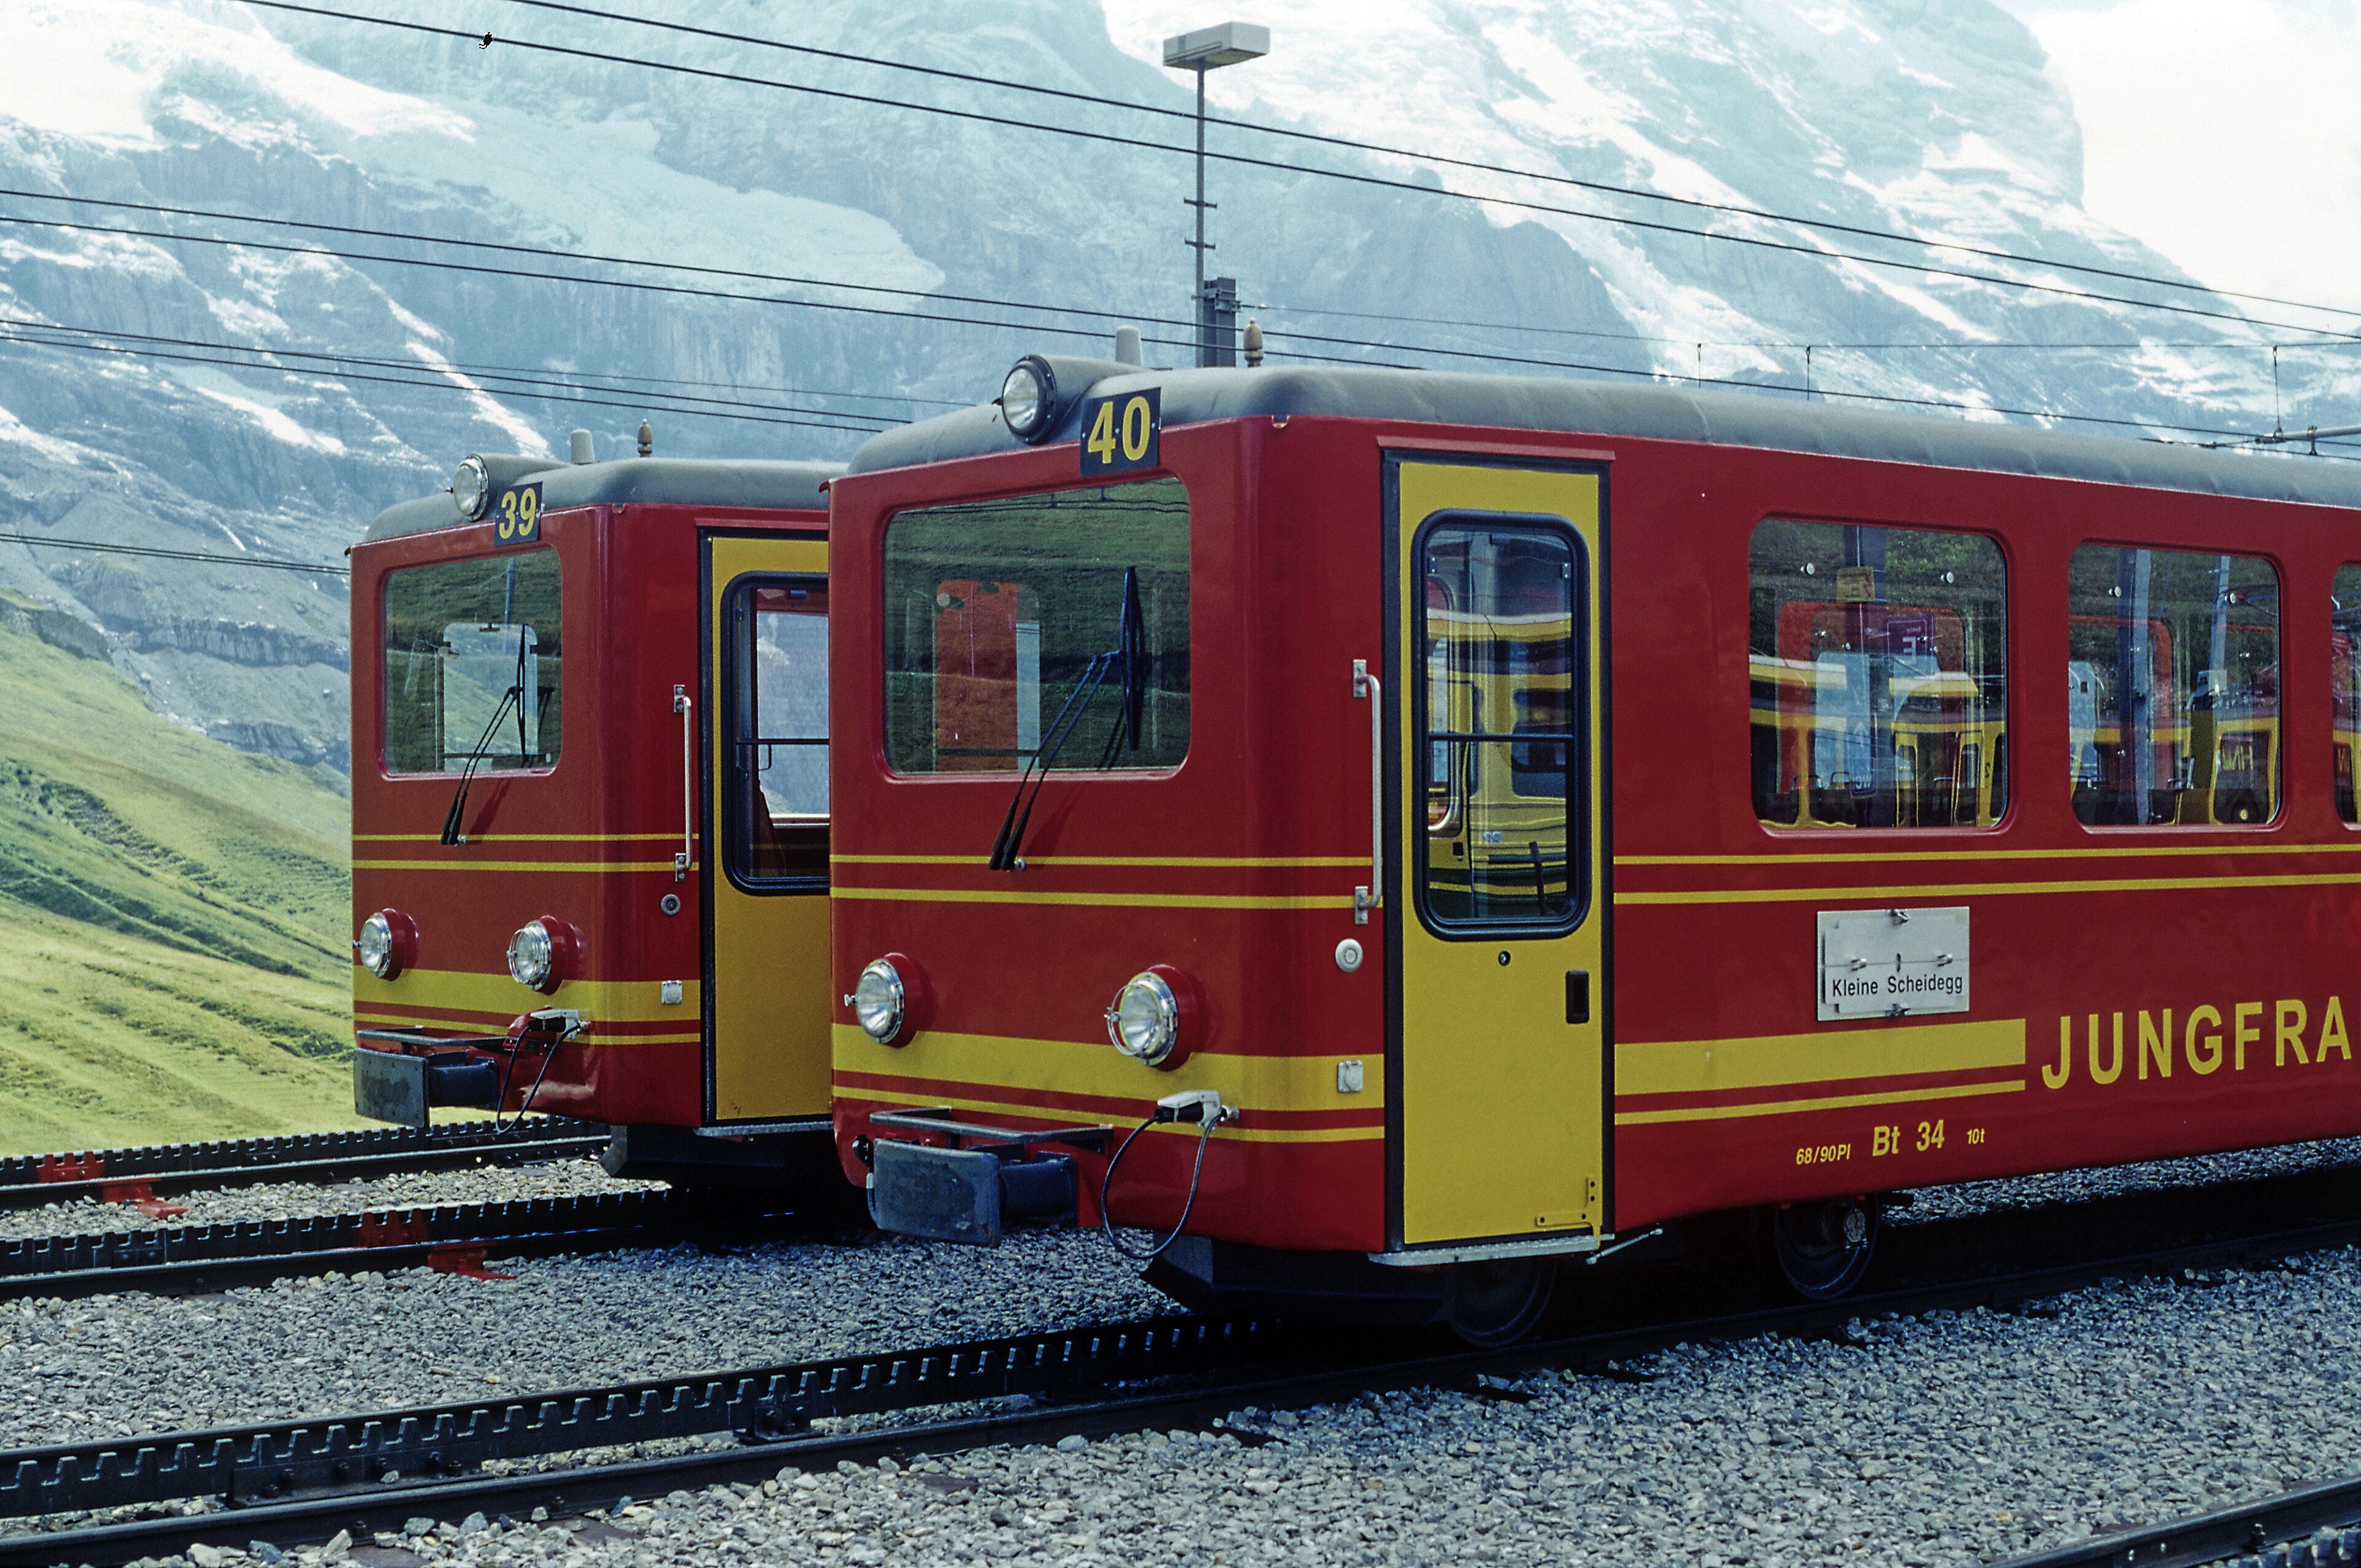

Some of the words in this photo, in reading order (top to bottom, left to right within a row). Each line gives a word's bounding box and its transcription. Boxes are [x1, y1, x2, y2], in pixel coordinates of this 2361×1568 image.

[1088, 396, 1150, 464] 40
[499, 487, 536, 539] 39
[1833, 978, 1878, 996] Kleine
[1888, 974, 1963, 995] Scheidegg
[2042, 996, 2352, 1089] JUNGFRA
[1872, 1125, 1900, 1156] Bt
[1916, 1119, 1945, 1151] 34
[1967, 1129, 1985, 1144] 10t
